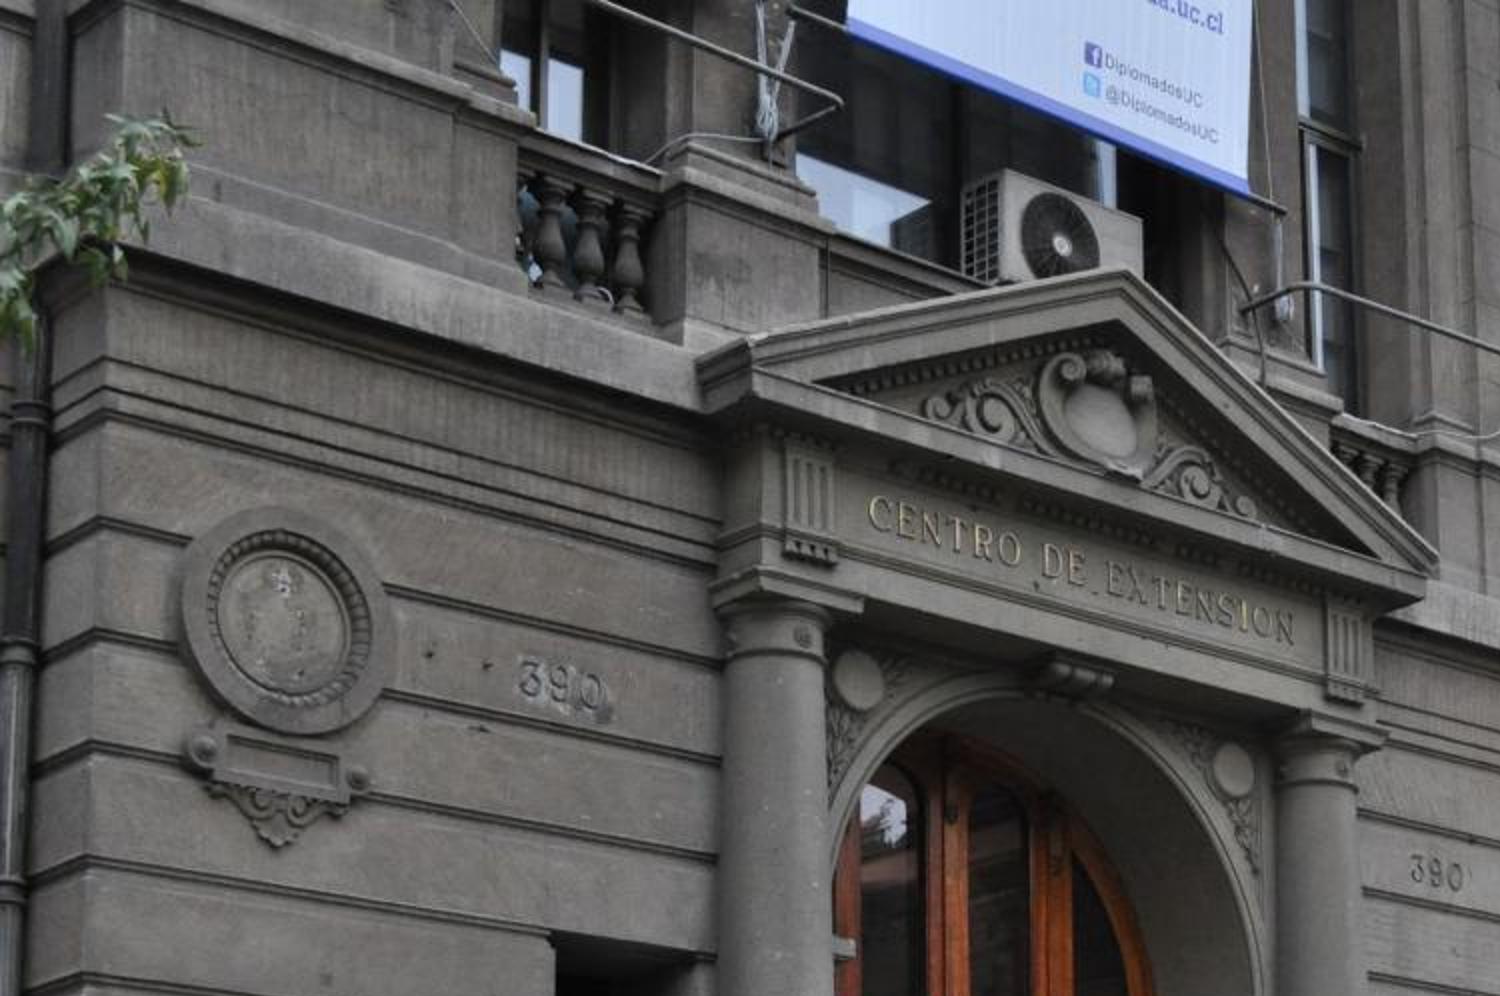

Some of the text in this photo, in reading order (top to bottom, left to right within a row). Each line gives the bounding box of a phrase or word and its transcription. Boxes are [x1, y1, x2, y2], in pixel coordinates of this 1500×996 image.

[1105, 52, 1203, 109] DiplomadosUC
[1105, 83, 1219, 145] @DiplomadosUC
[867, 495, 1296, 647] CENTRO DE EXTENSION
[518, 656, 606, 714] 390
[1410, 853, 1464, 893] 390
